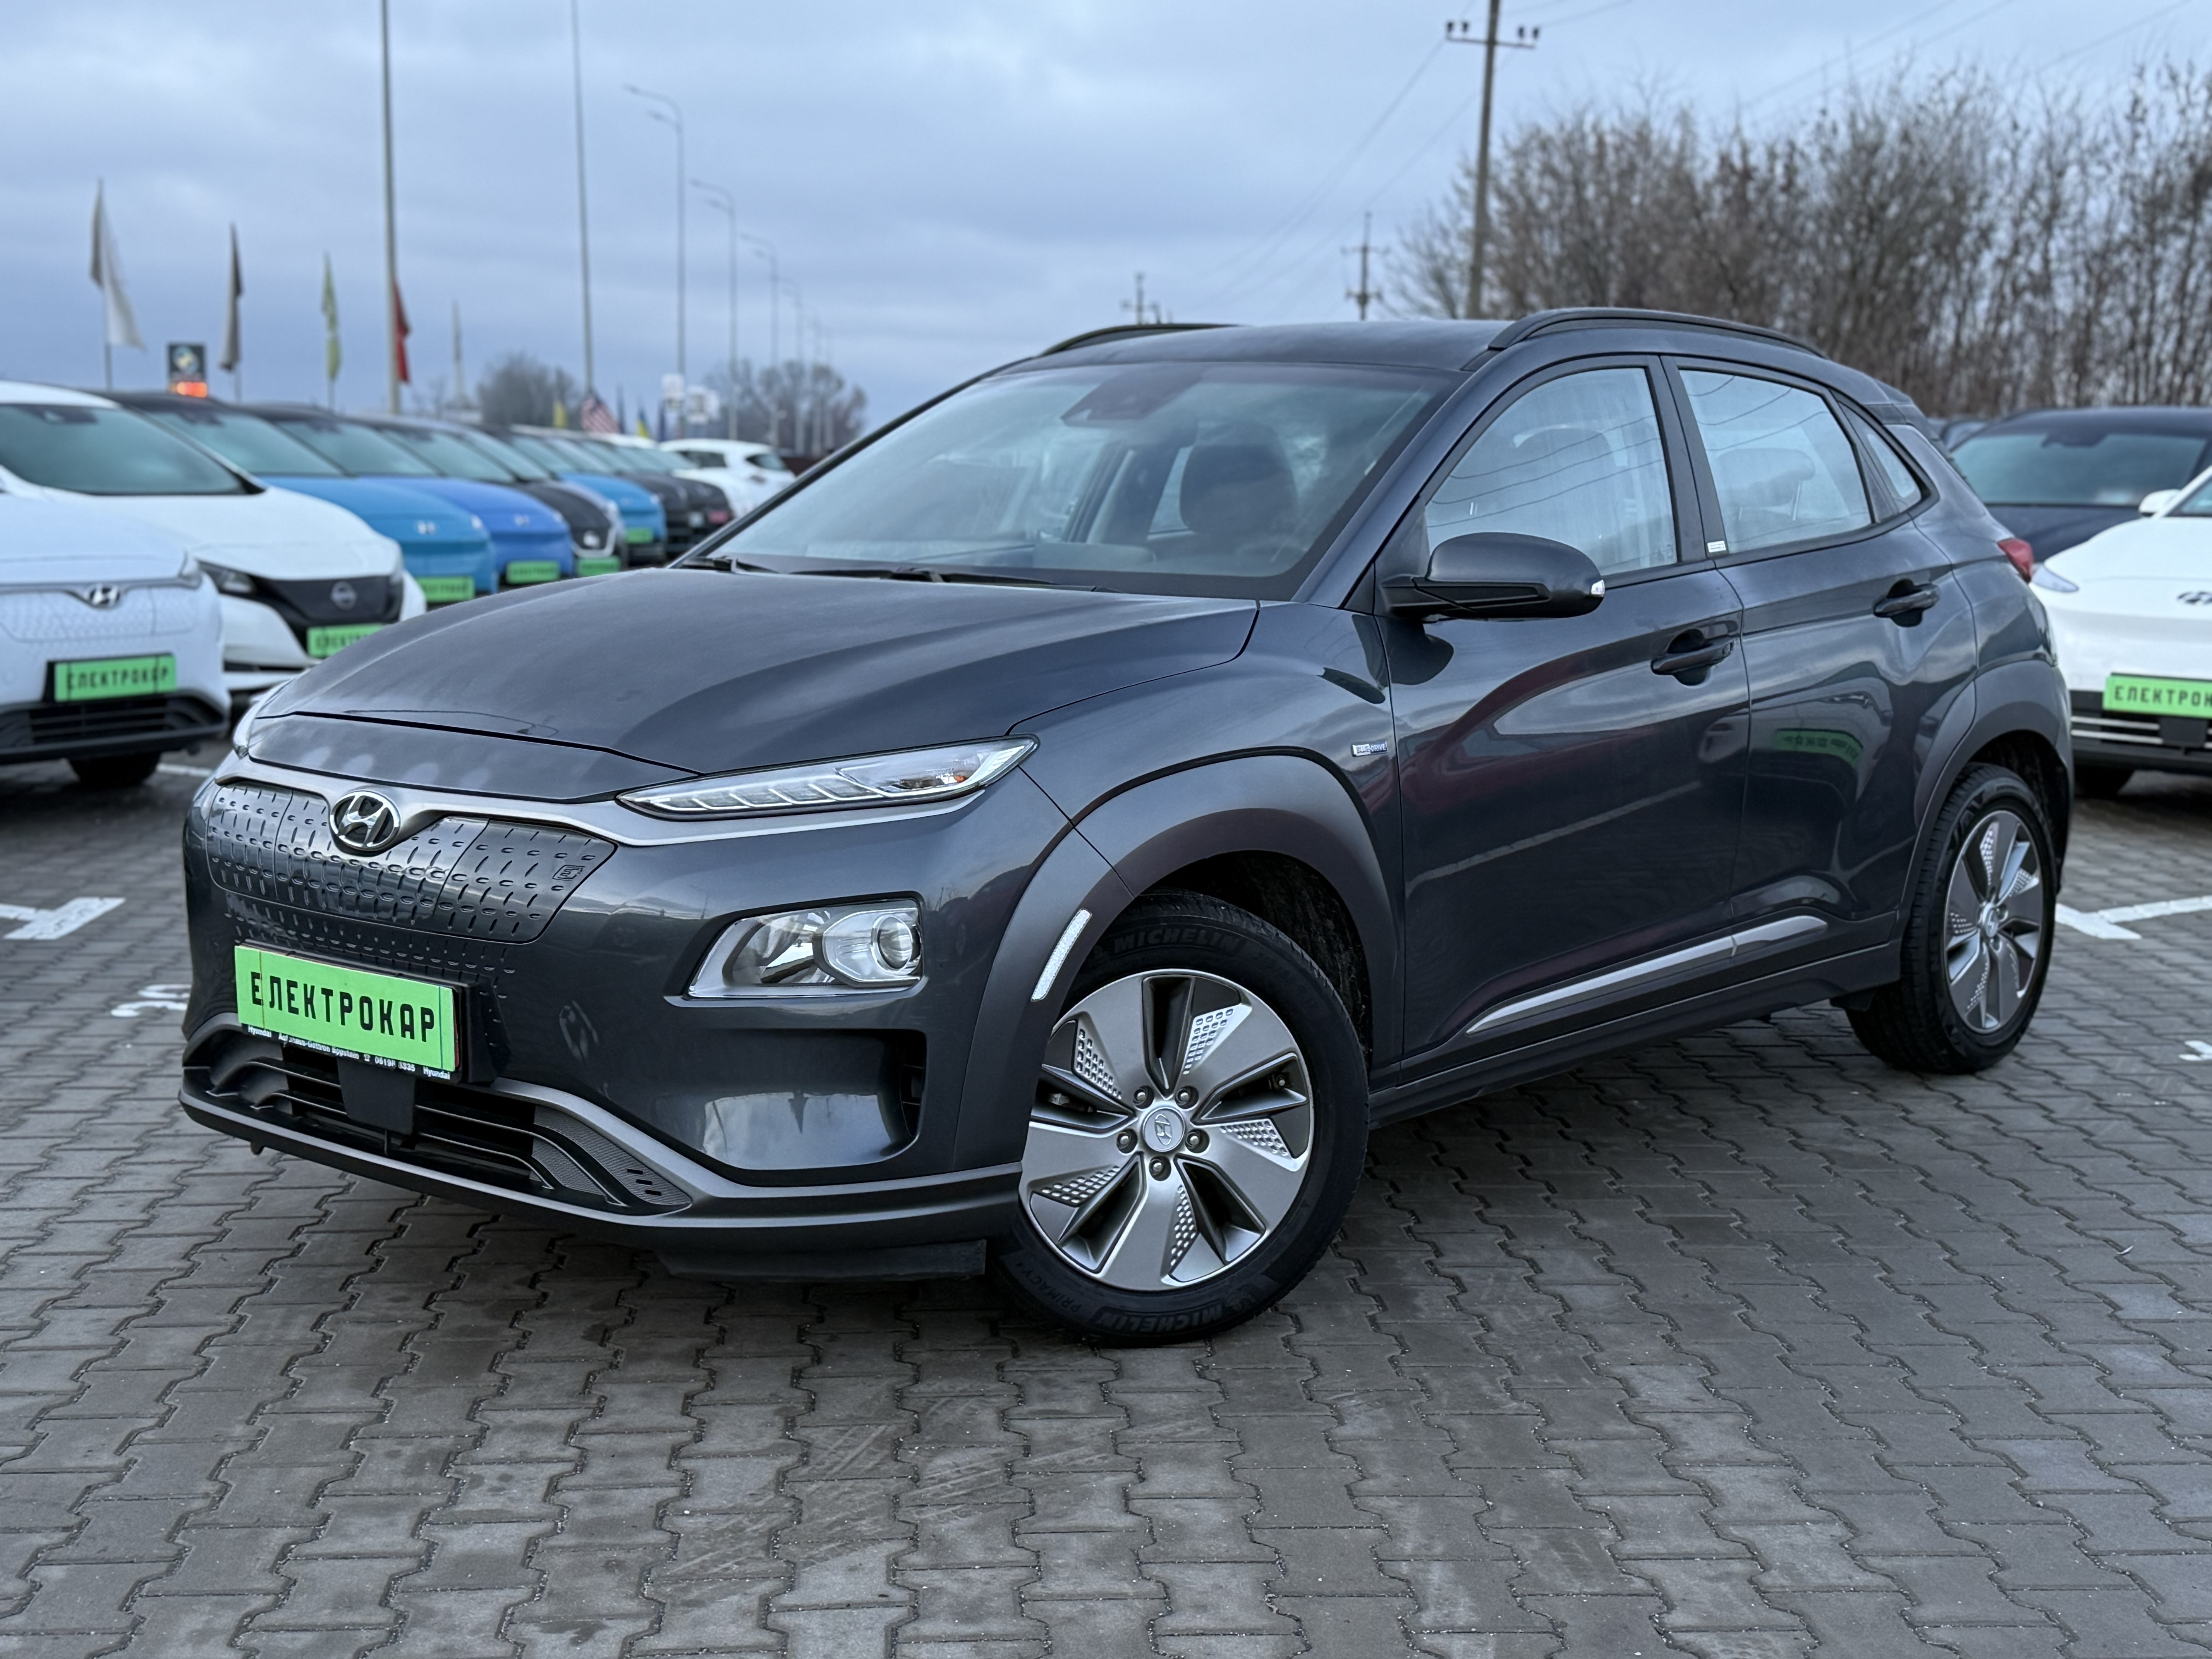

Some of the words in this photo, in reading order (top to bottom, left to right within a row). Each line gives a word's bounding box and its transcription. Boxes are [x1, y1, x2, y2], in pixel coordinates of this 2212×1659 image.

[1114, 928, 1240, 954] MICHELIN
[251, 971, 434, 1042] ЕЛЕКТРОКАР
[423, 1066, 450, 1080] Hyundai
[1022, 1269, 1083, 1312] PRIMACY
[1095, 1303, 1223, 1333] MICHELIN
